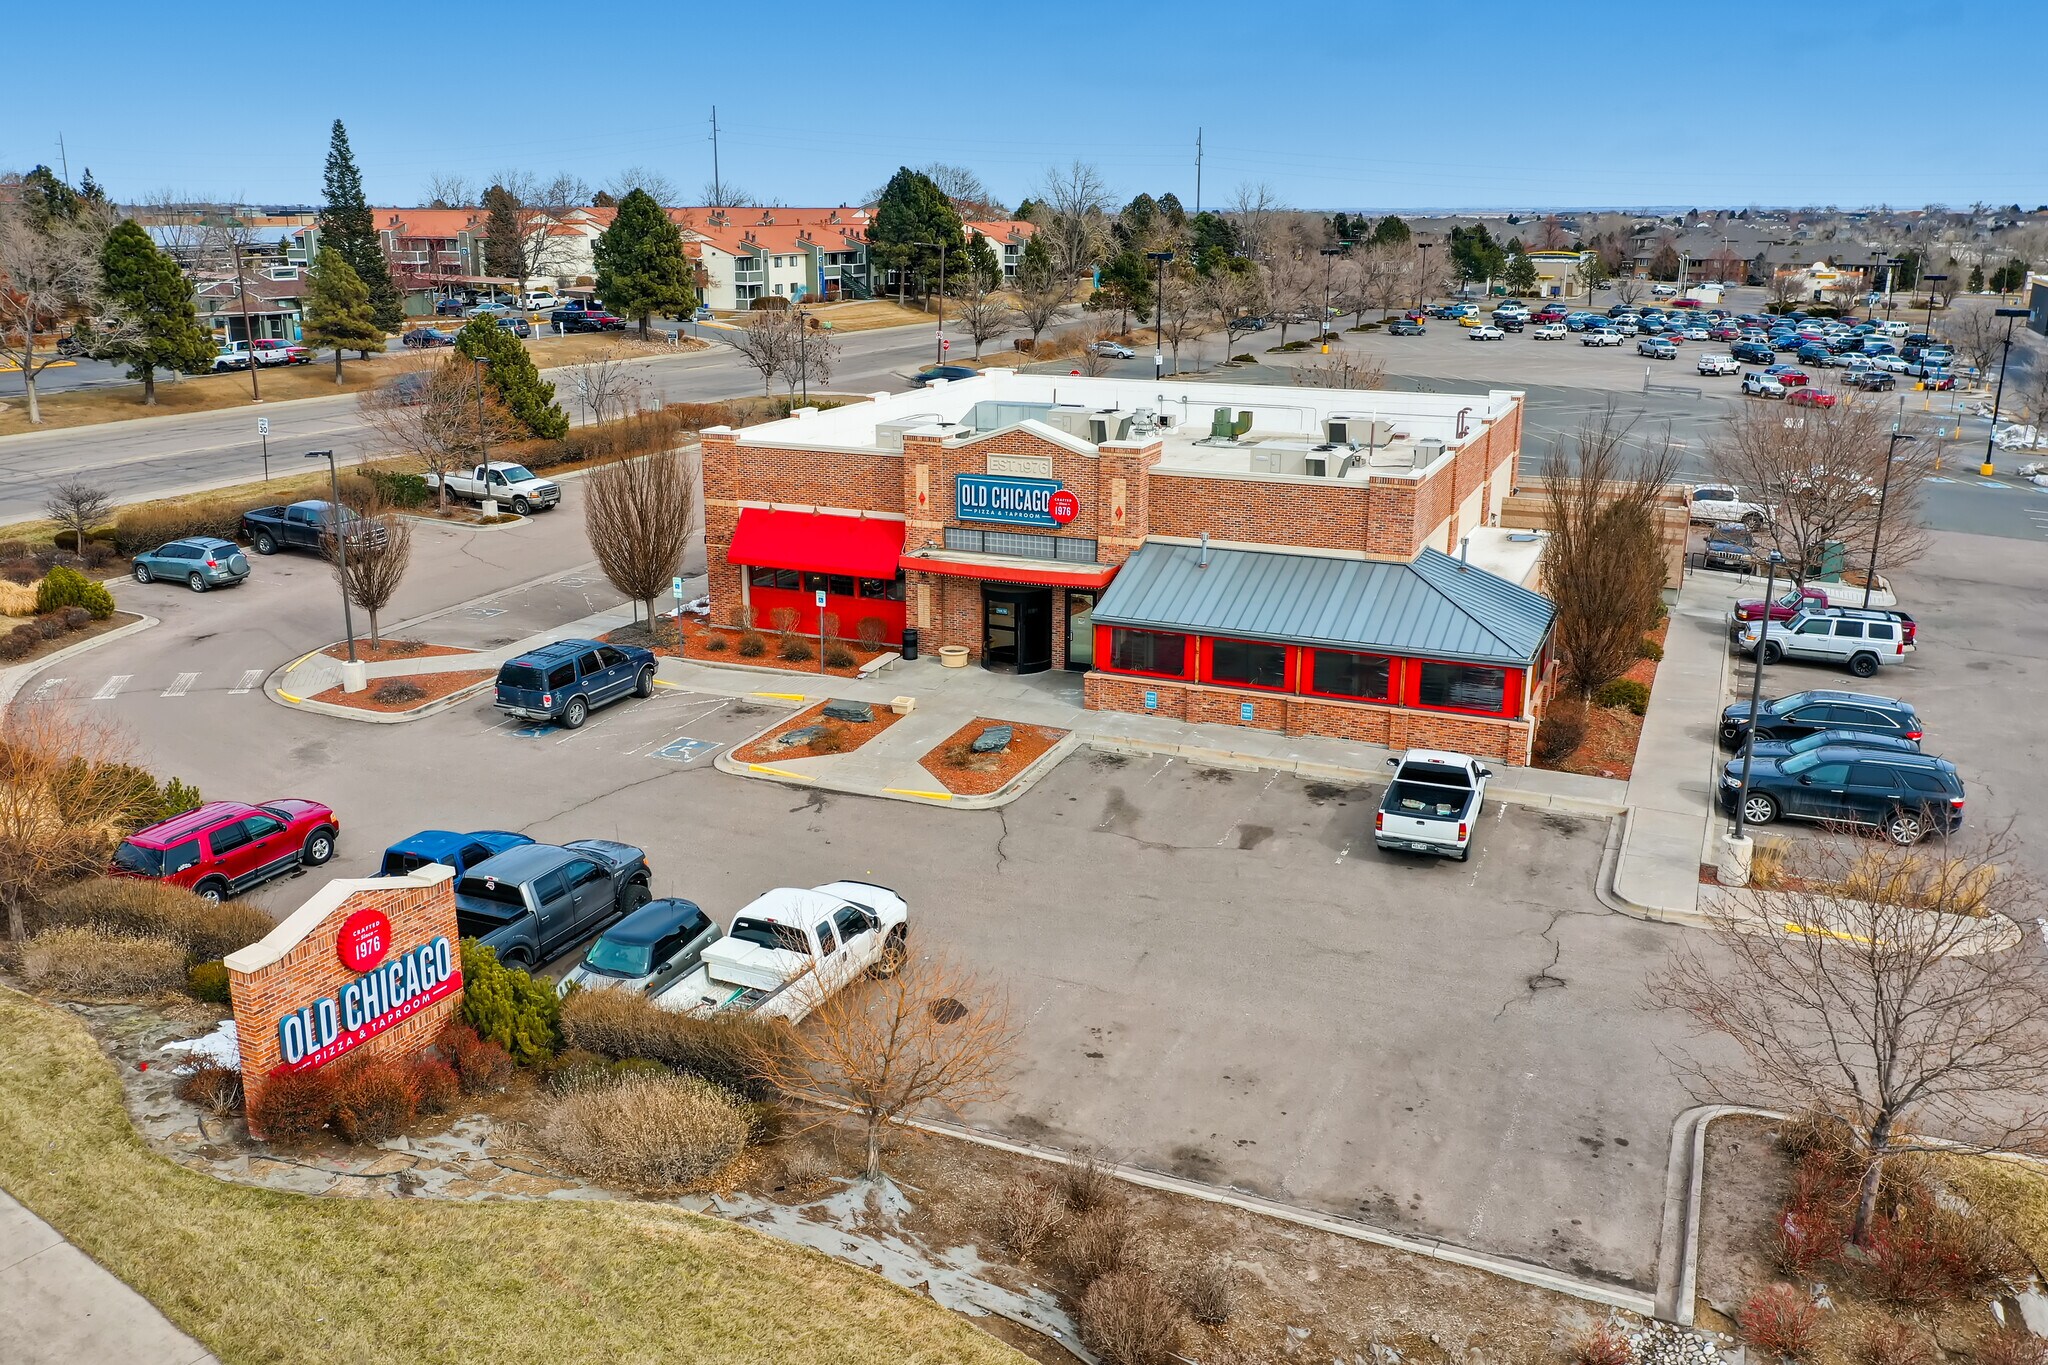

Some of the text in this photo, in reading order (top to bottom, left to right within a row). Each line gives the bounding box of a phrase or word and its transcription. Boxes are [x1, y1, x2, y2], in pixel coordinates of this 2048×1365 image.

[259, 426, 267, 434] 30
[962, 484, 1050, 513] OLD CHICAGO
[1005, 511, 1041, 519] TAPROOM
[1055, 505, 1071, 516] 1976
[352, 920, 380, 937] CRAFTED
[360, 931, 374, 940] Since
[355, 935, 381, 961] 1976
[281, 937, 452, 1065] OLD CHICAGO
[314, 993, 431, 1065] PIZZA & TAPROOM
